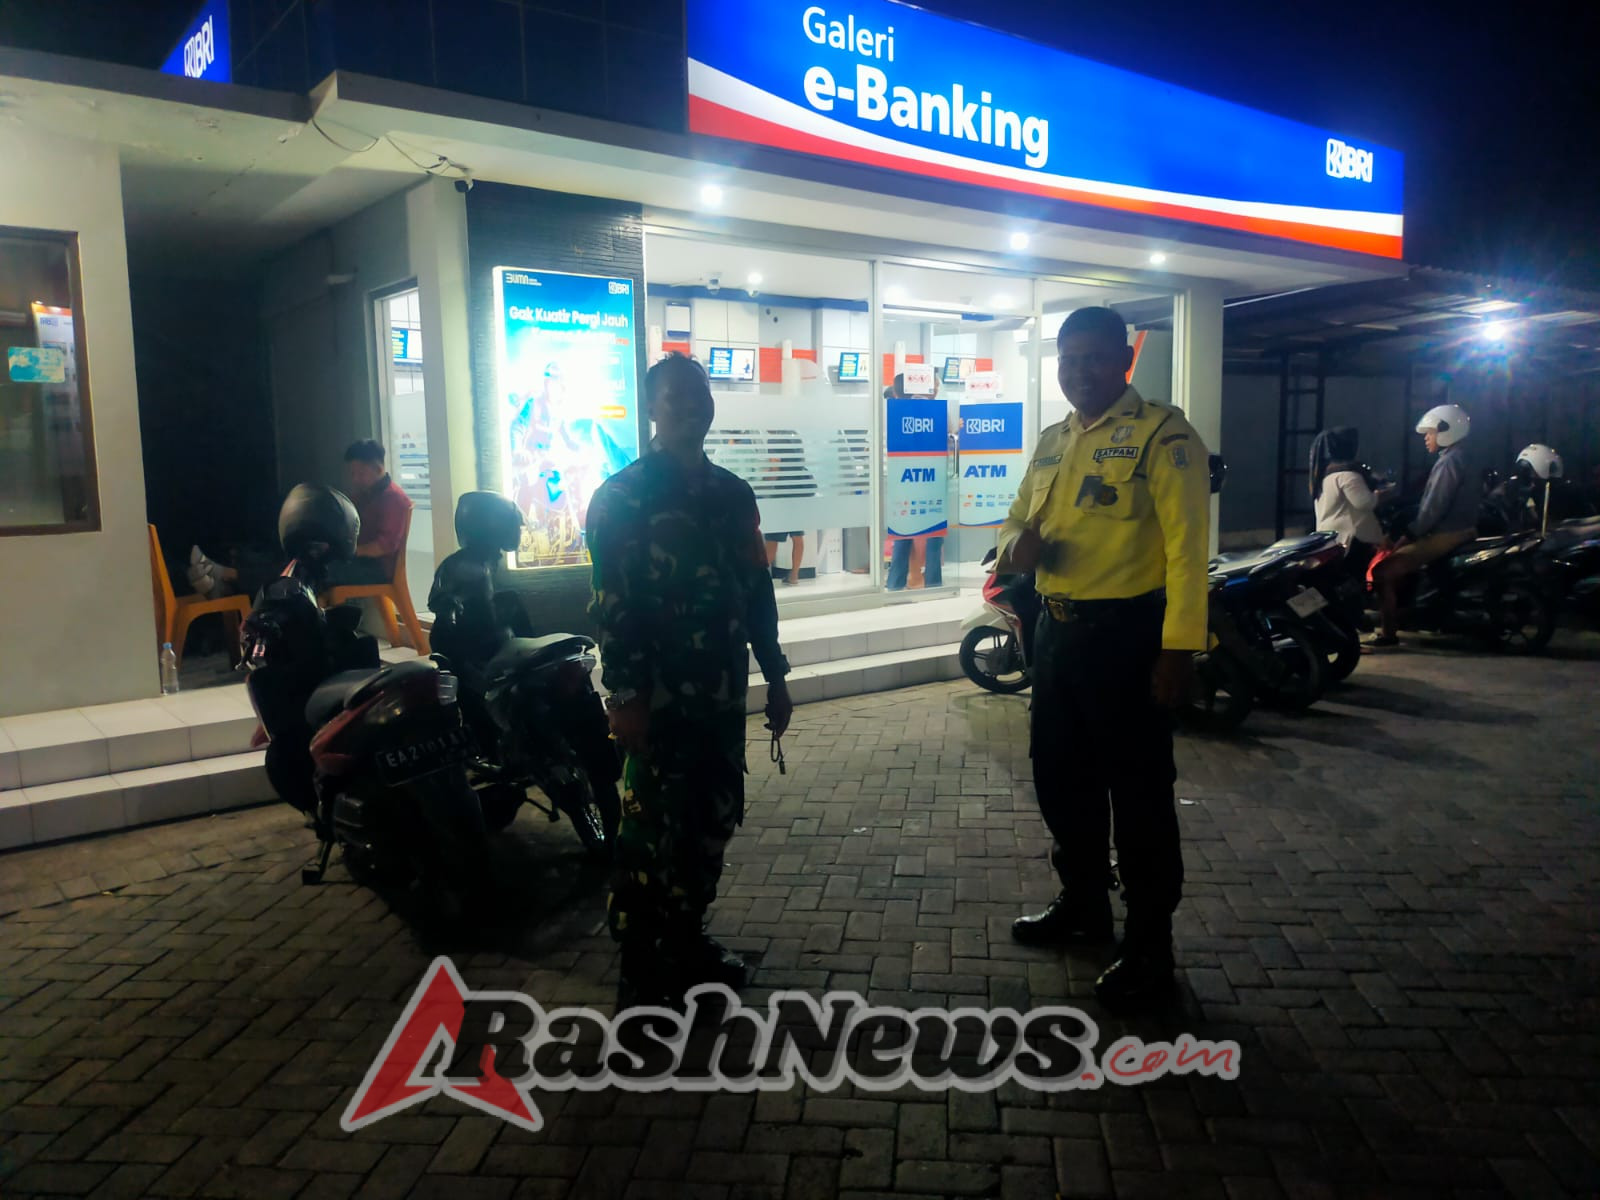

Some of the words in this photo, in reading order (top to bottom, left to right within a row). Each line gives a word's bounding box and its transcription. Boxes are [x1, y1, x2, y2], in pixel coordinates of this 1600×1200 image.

[802, 6, 894, 62] Galeri
[195, 14, 214, 78] BRI
[803, 63, 1049, 169] e-Banking
[1344, 145, 1373, 183] BRI
[509, 306, 534, 322] Gak
[535, 308, 570, 324] Kuatir
[571, 310, 600, 329] Pergi
[601, 313, 628, 328] Jauh
[914, 417, 934, 433] BRI
[981, 418, 1005, 433] BRI
[1095, 447, 1137, 458] SATPAM
[901, 468, 936, 482] ATM
[964, 465, 1007, 477] ATM
